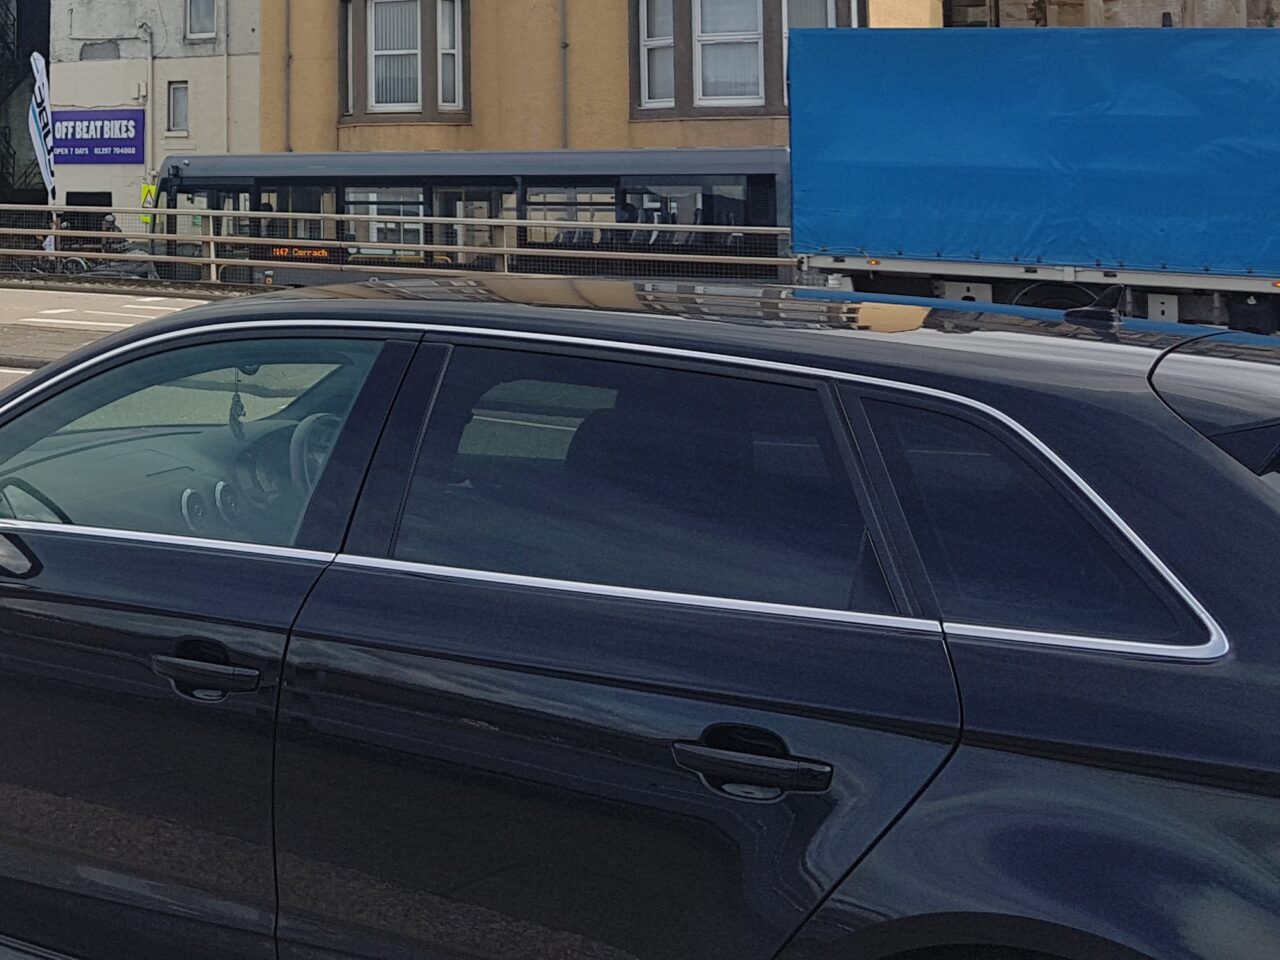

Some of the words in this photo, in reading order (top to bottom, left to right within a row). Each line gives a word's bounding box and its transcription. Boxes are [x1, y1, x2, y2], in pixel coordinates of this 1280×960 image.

[54, 121, 75, 139] OFF
[75, 120, 102, 139] BEAT
[103, 119, 136, 138] BIKES
[53, 147, 69, 155] OPEN
